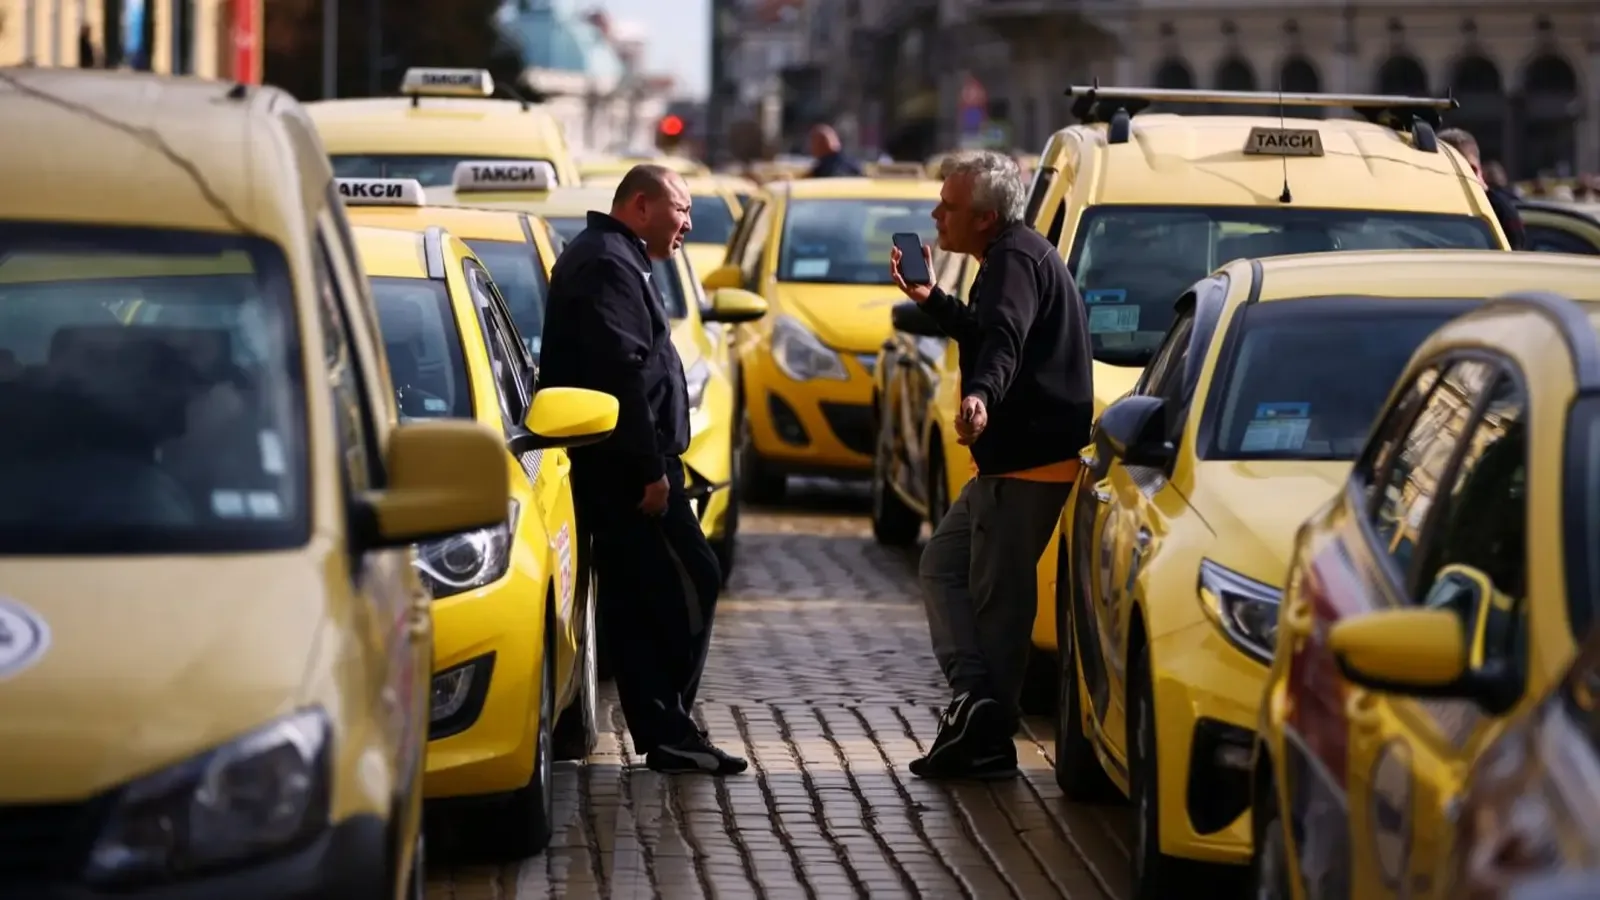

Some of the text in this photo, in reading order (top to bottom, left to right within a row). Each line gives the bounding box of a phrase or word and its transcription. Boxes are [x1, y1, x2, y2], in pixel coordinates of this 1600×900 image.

[1256, 133, 1313, 149] ТАКСИ
[471, 165, 536, 182] ТАКСИ
[338, 183, 402, 198] АКСИ
